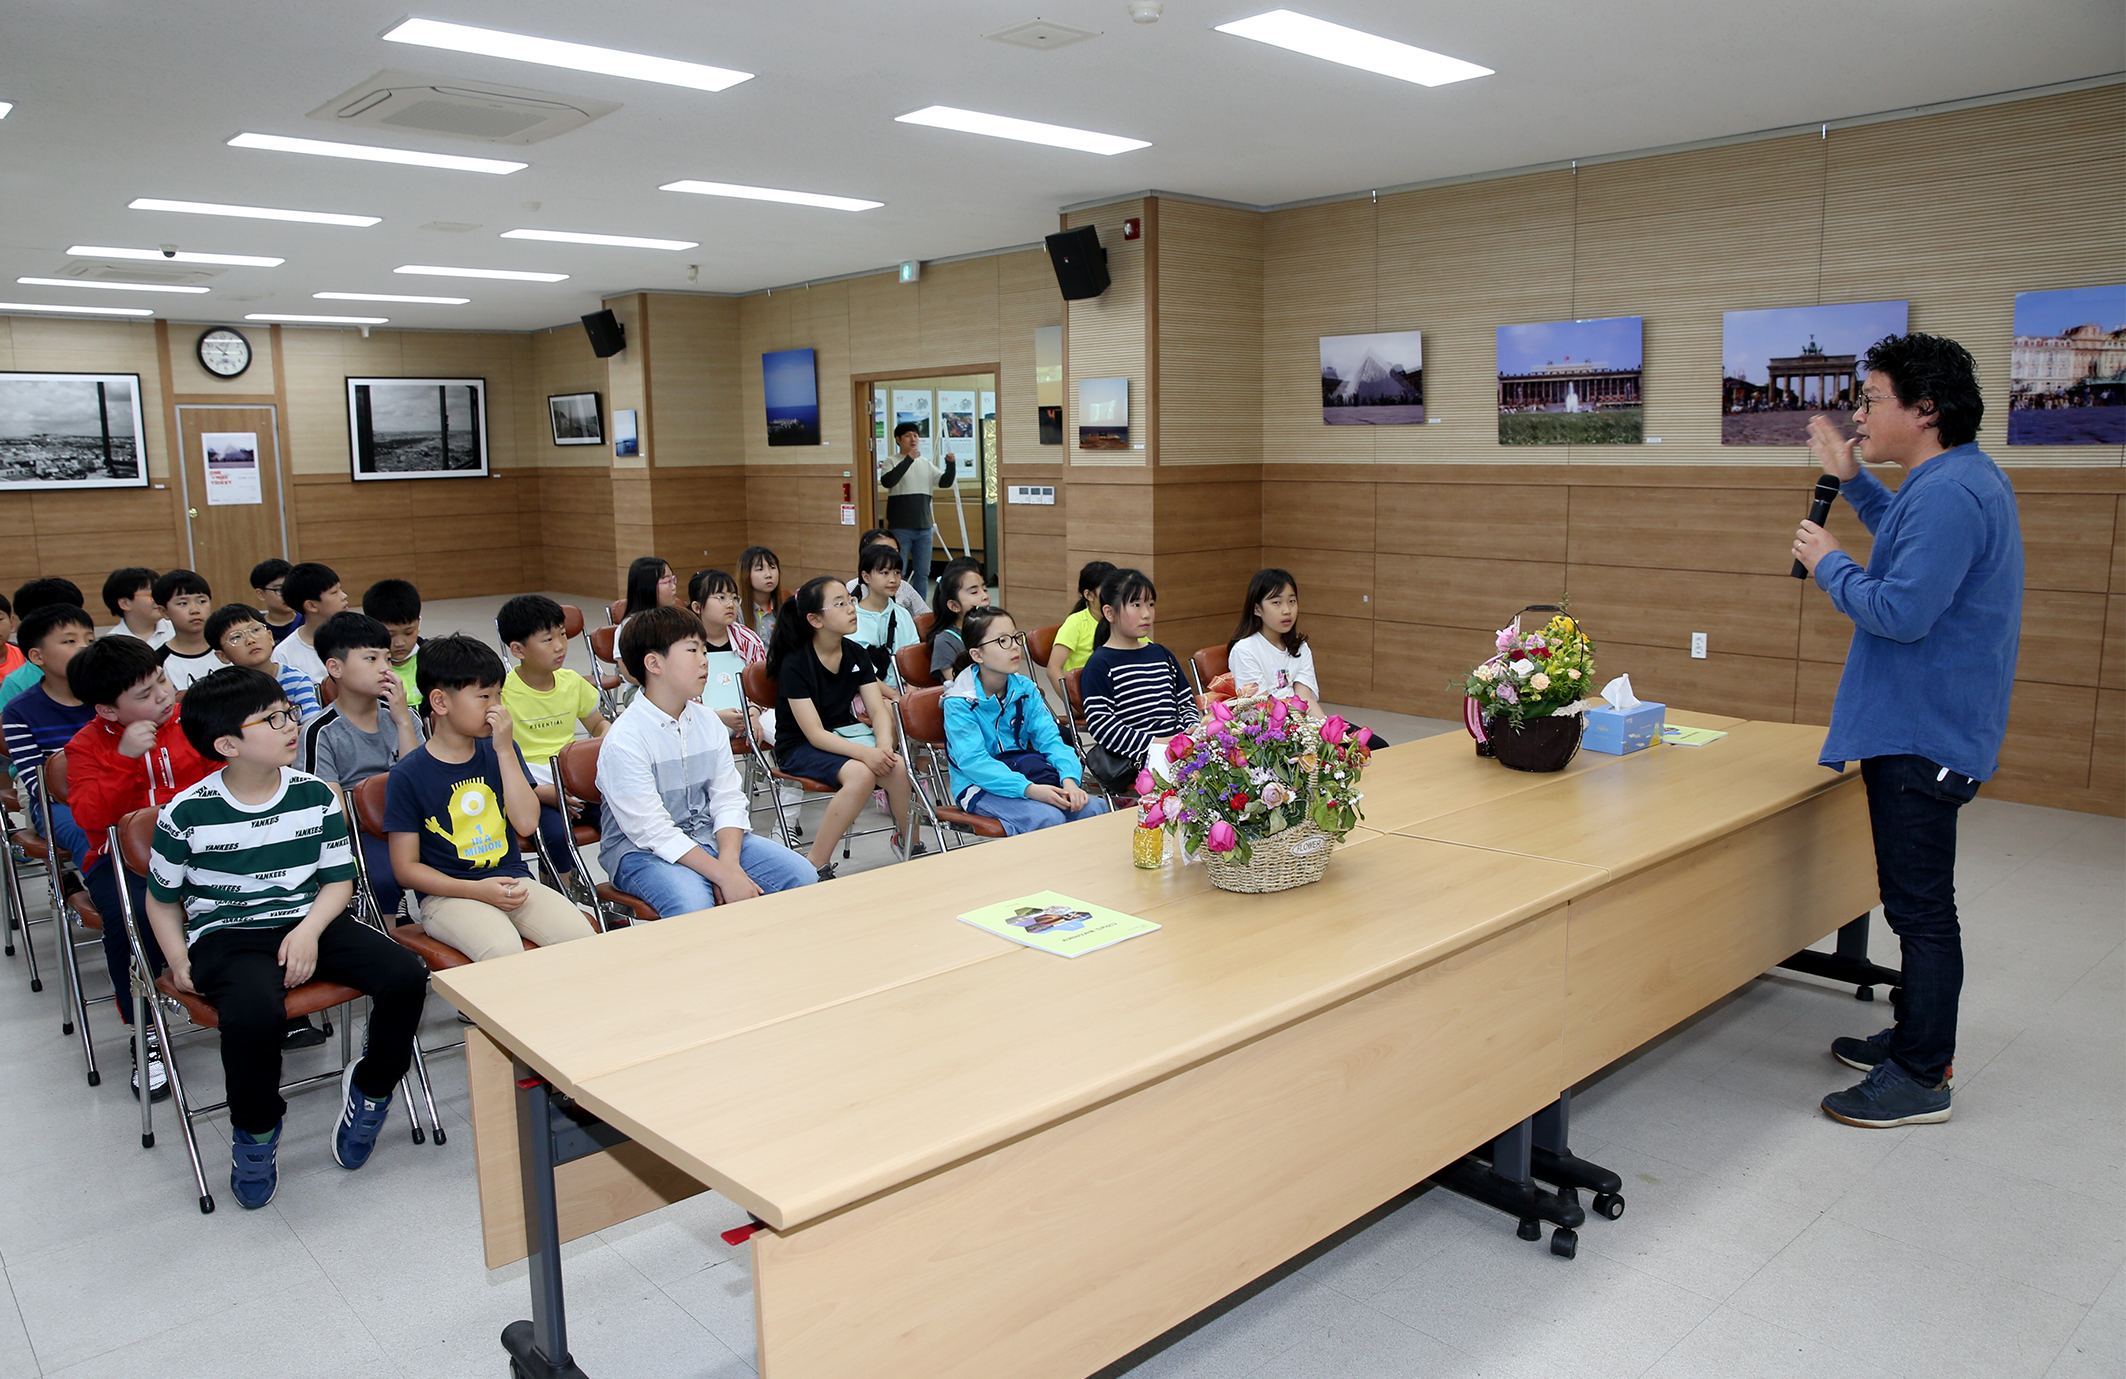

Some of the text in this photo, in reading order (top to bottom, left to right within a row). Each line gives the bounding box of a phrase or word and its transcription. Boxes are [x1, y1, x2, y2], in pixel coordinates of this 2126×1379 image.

[529, 719, 563, 729] ESSENTIAL
[294, 825, 323, 838] YANKEES
[475, 823, 484, 835] 1
[471, 834, 492, 846] IN A
[1296, 839, 1321, 852] FLOWER
[205, 842, 240, 852] YANKEES
[464, 840, 503, 857] MINION
[254, 870, 287, 880] YANKEES
